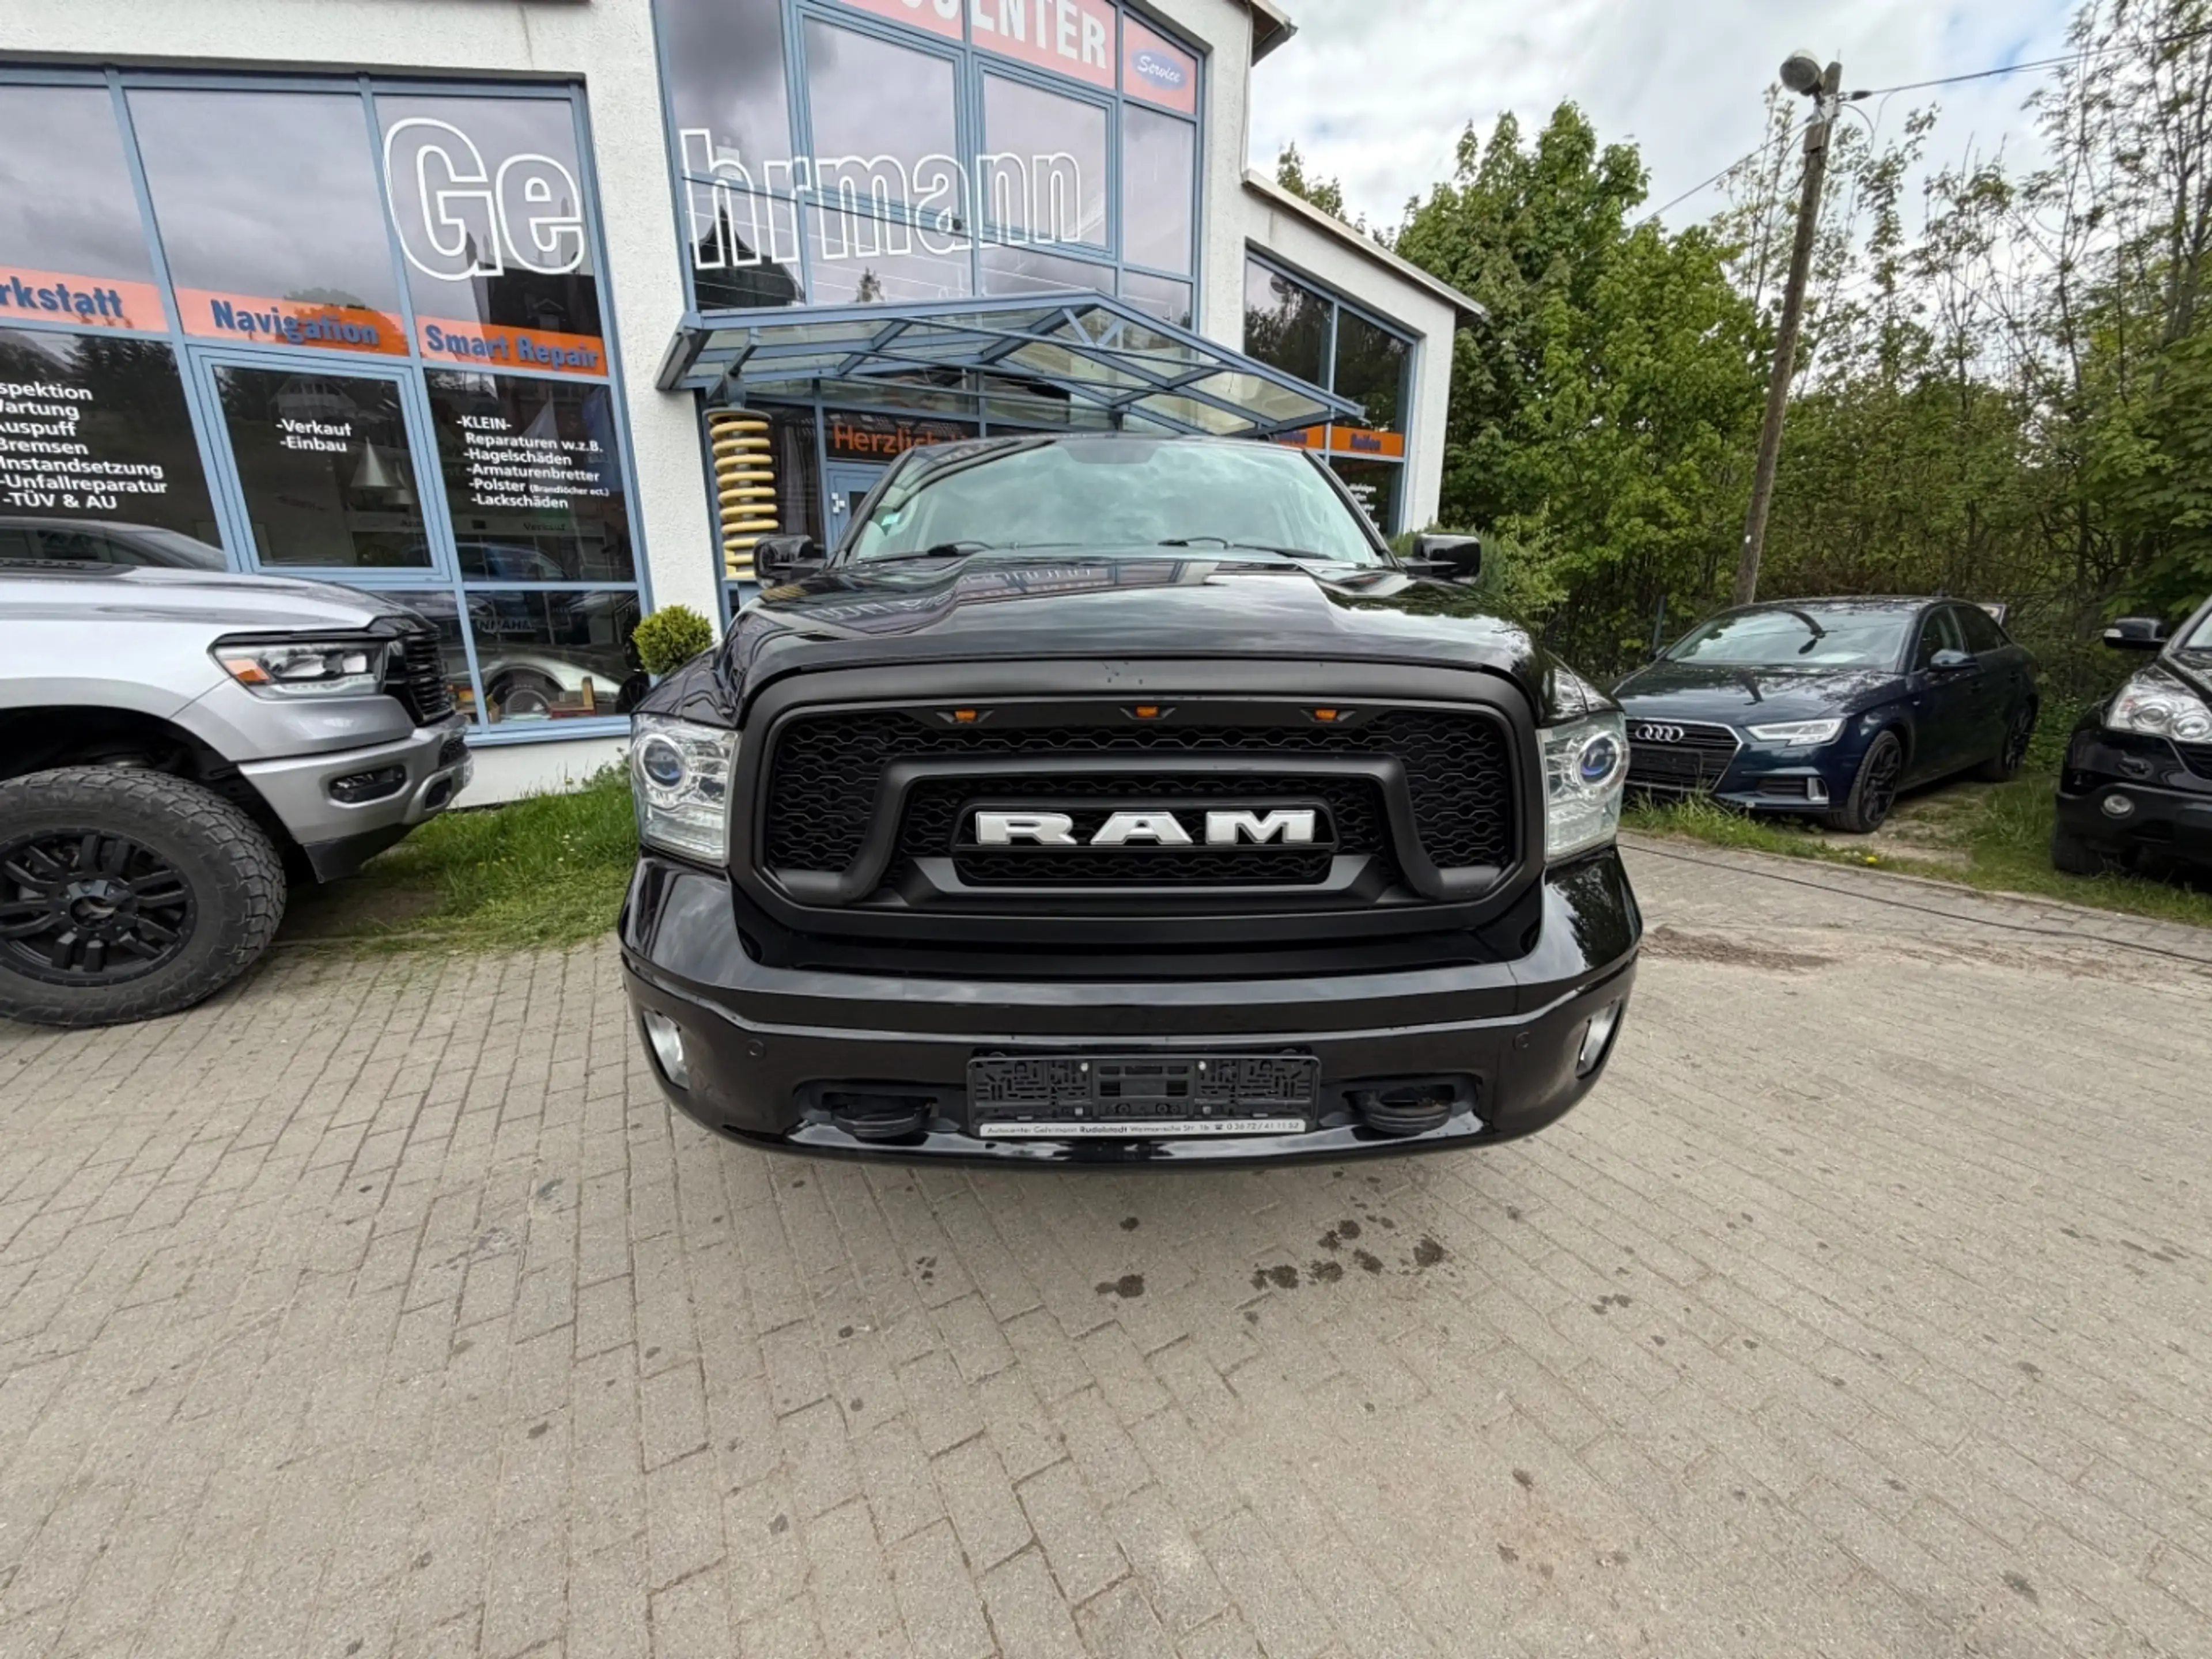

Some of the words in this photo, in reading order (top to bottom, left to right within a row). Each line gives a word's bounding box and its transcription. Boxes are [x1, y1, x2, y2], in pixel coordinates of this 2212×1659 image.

[1137, 55, 1181, 83] Service
[210, 299, 380, 346] Navigation
[425, 324, 509, 360] Smart
[517, 335, 598, 369] Repair
[0, 399, 80, 421] artung
[456, 415, 513, 430] -KLEIN-
[279, 435, 347, 453] -Einbau
[464, 432, 558, 449] Reparaturen
[463, 448, 573, 467] -Hagelschäden
[466, 463, 601, 482] -Armaturenbretter
[468, 478, 525, 493] -Polster
[3, 489, 55, 508] -TÜV
[63, 494, 81, 509] &
[86, 495, 118, 510] AU
[471, 493, 569, 509] -Lackschäden
[975, 809, 1316, 845] RAM
